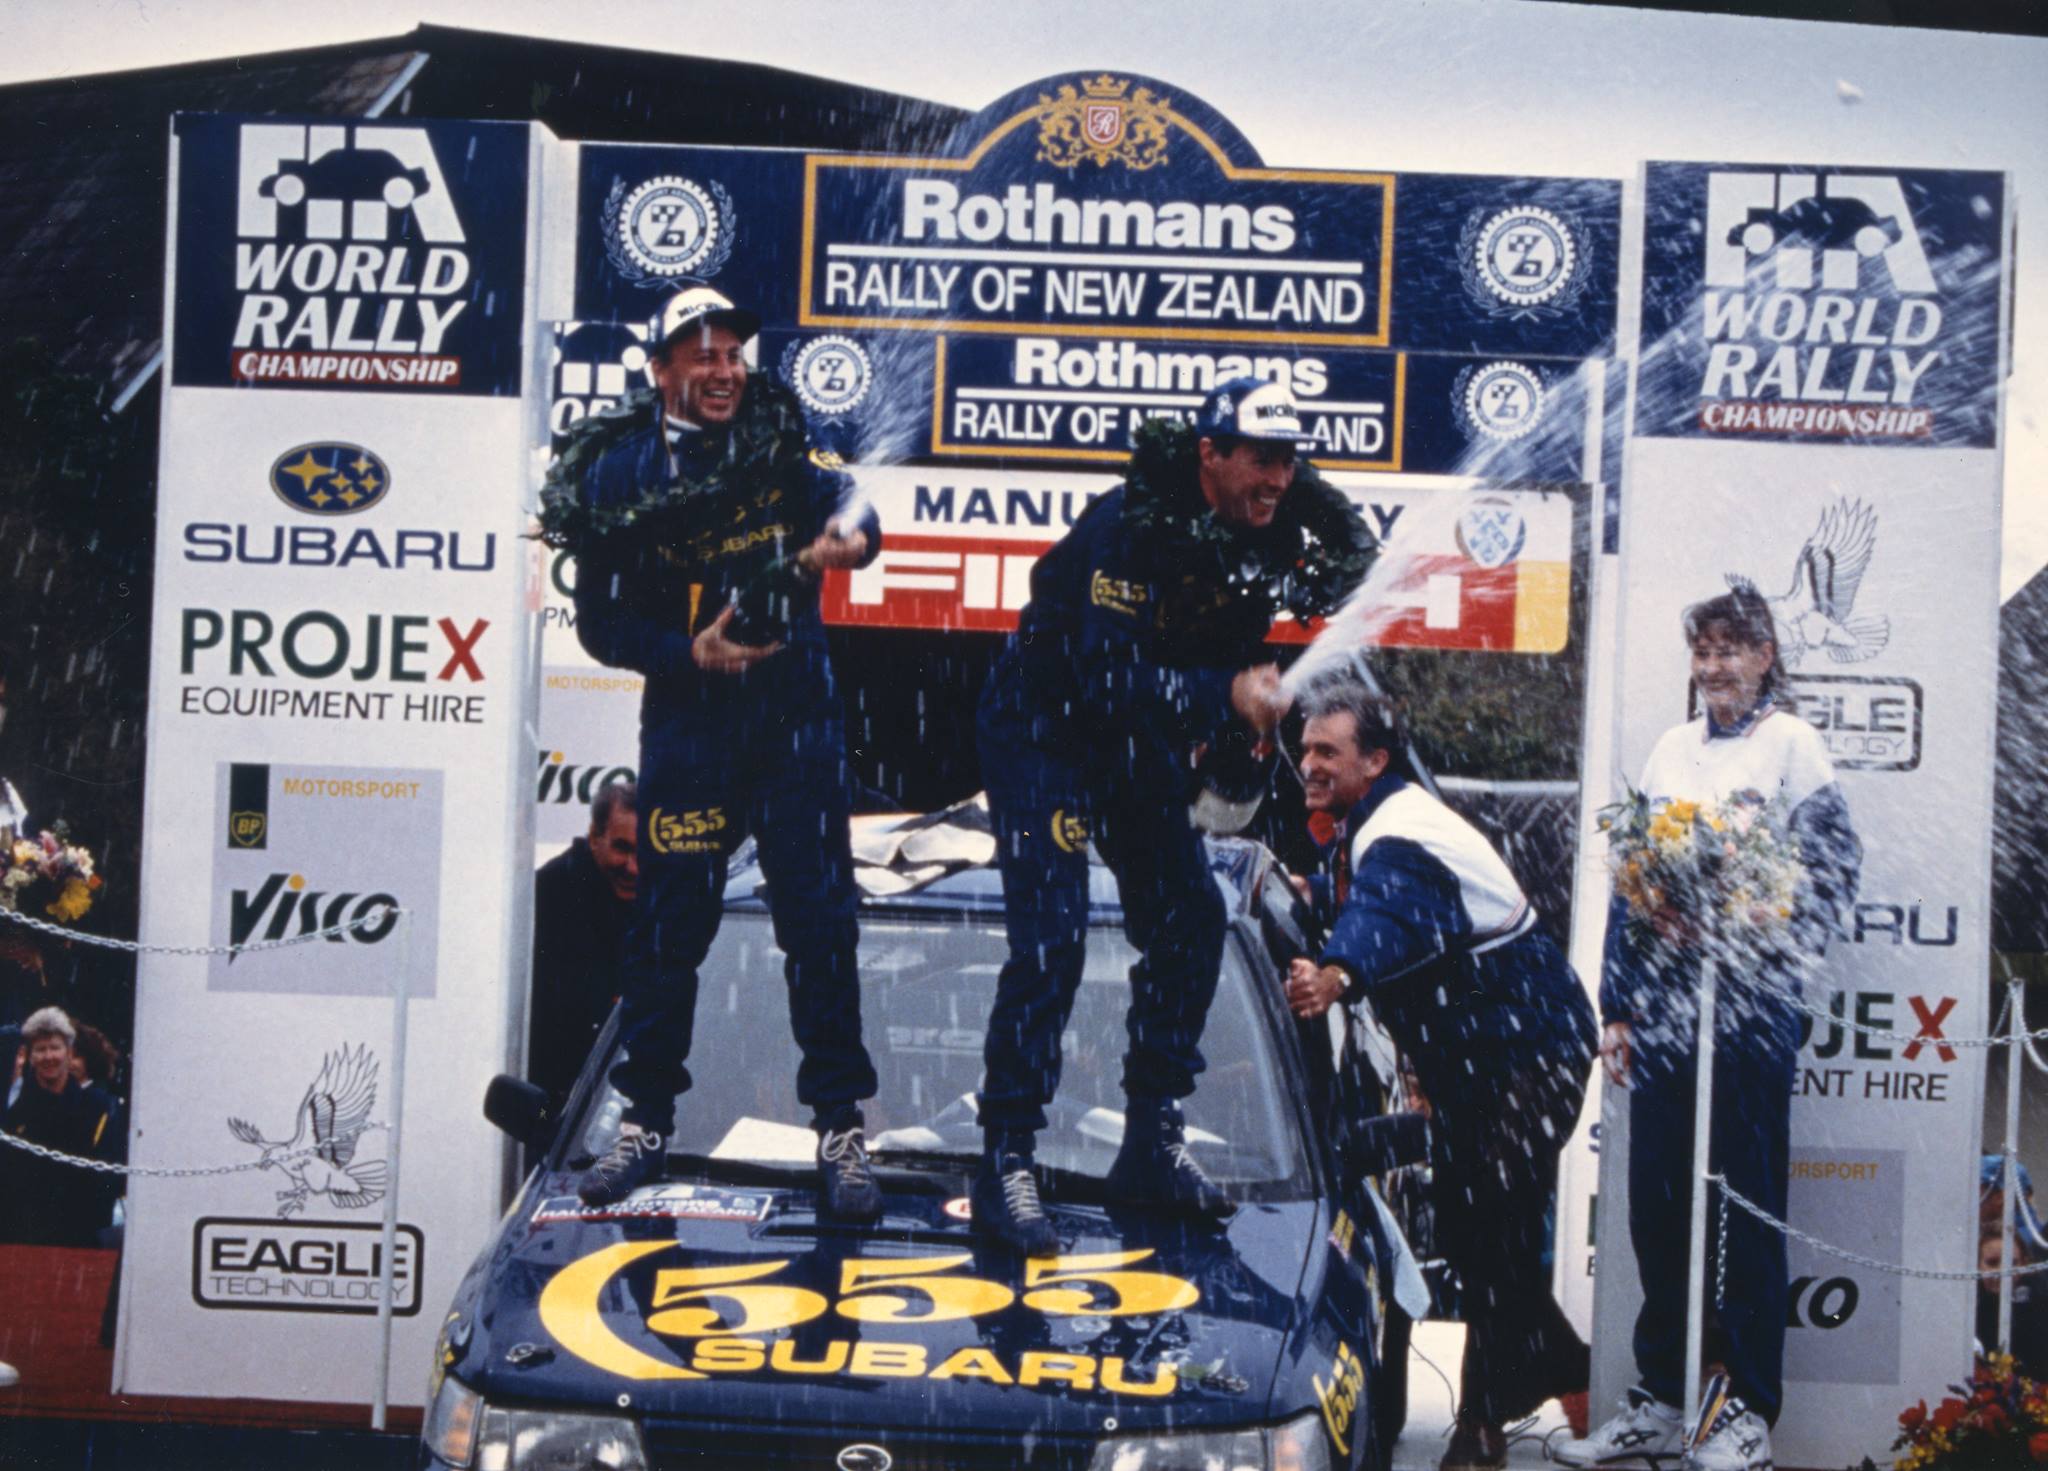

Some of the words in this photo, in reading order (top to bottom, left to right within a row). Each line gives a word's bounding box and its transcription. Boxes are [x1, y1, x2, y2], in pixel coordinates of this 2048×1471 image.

[903, 178, 1296, 252] Rothmans
[236, 243, 470, 296] WORLD
[825, 262, 960, 311] RALLY
[972, 266, 1033, 312] OF
[1046, 270, 1146, 316] NEW
[1157, 272, 1366, 324] ZEALAND
[232, 294, 467, 354] RALLY
[1703, 291, 1942, 347] WORLD
[238, 353, 459, 384] CHAMPIONSHIP
[1014, 338, 1328, 397] Rothmans
[1700, 343, 1940, 404] RALLY
[953, 401, 1062, 443] RALLY
[1071, 404, 1121, 444] OF
[1702, 403, 1930, 435] CHAMPIONSHIP
[914, 485, 1102, 528] MANU
[183, 522, 497, 572] SUBARU
[180, 608, 491, 683] PROJEX
[180, 686, 393, 721] EQUIPMENT
[404, 694, 486, 724] HIRE
[546, 675, 646, 693] MOTORSPOR
[1792, 694, 1906, 733] GLE
[283, 777, 421, 800] MOTORSPORT
[237, 818, 261, 835] BP
[660, 807, 727, 840] 555
[1797, 990, 1958, 1063] JEX
[1864, 1070, 1949, 1102] HIRE
[1790, 1161, 1879, 1181] ORSPORT
[210, 1237, 409, 1280] EAGLE
[647, 1248, 1200, 1338] 555
[692, 1337, 1179, 1396] SUBARU
